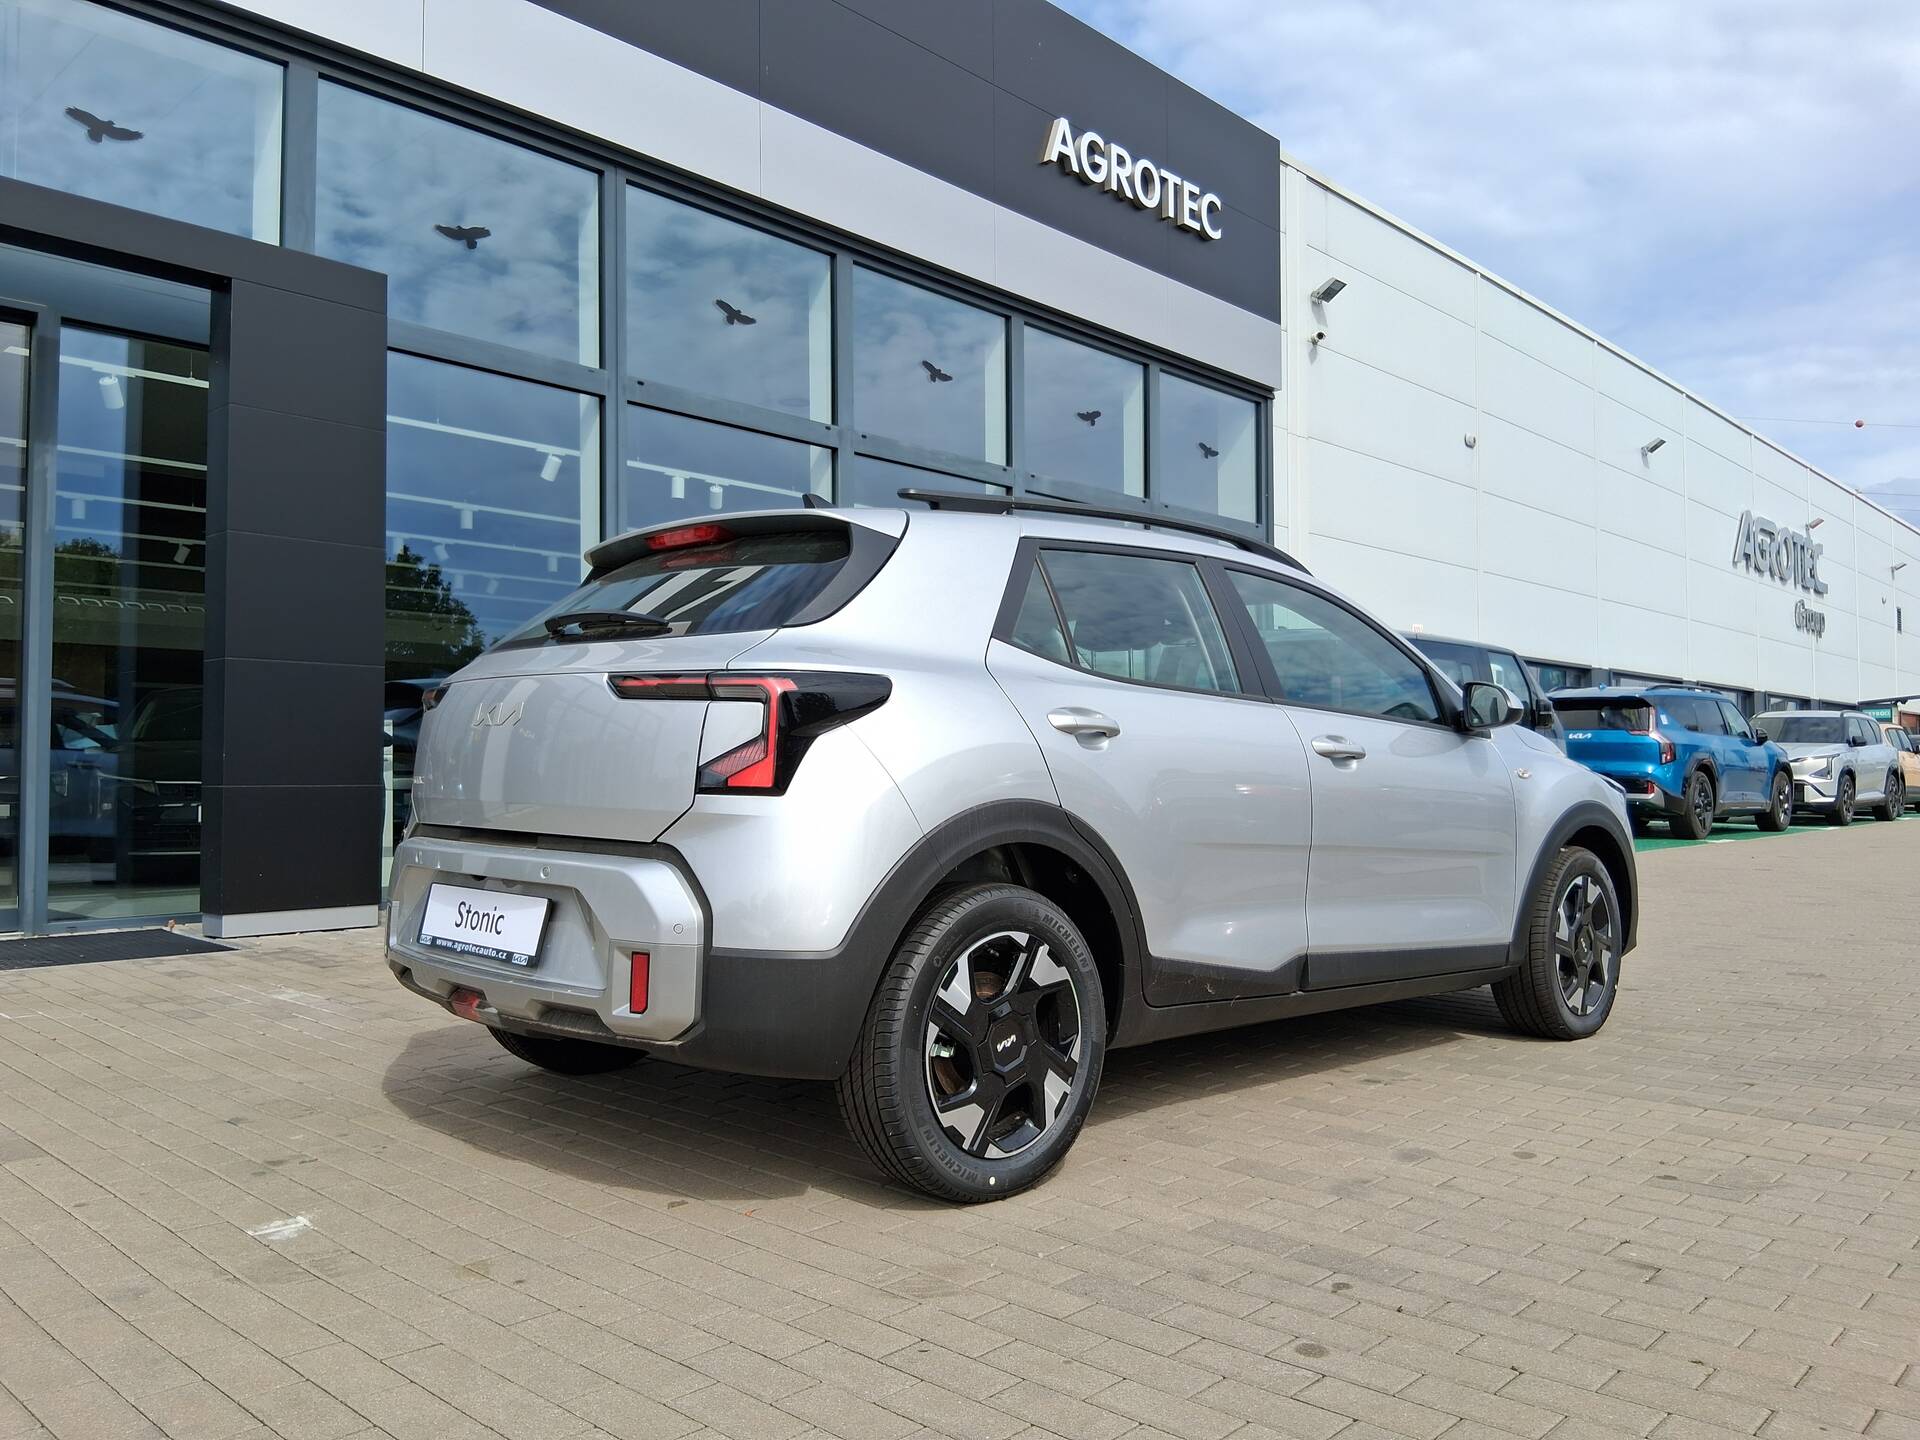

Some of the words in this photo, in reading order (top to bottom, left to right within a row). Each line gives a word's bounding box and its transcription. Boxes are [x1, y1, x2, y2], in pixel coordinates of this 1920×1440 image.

[1042, 117, 1222, 240] AGROTEC
[1733, 510, 1828, 596] AGROTEC
[1795, 599, 1826, 641] Group
[455, 901, 505, 935] Stonic
[1041, 913, 1088, 969] MICHELIN
[436, 938, 507, 959] www.agrotecauto.cz
[922, 1127, 979, 1182] MICHELIN
